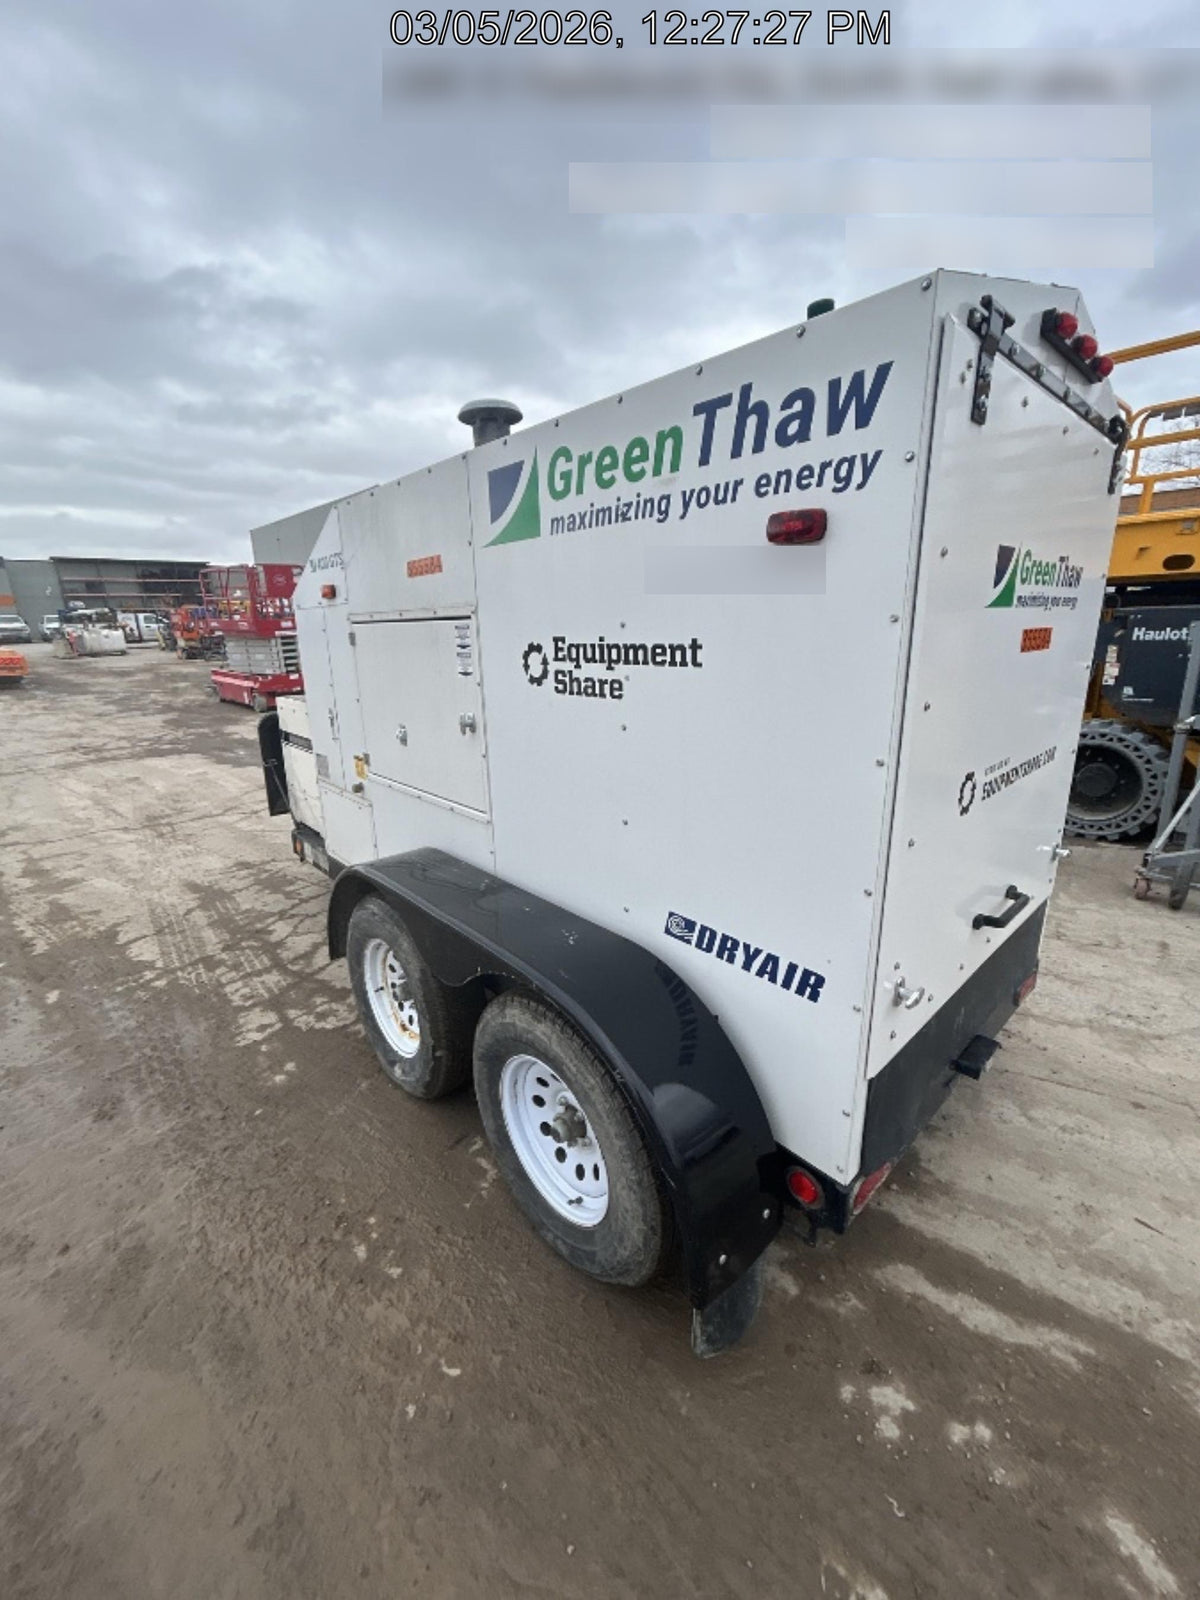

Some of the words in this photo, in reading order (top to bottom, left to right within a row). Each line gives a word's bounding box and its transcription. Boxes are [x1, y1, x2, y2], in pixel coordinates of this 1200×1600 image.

[549, 492, 671, 536] maximizing
[679, 476, 744, 519] your
[754, 449, 884, 498] energy
[552, 636, 704, 670] Equipment
[694, 924, 826, 1004] DRYAIR
